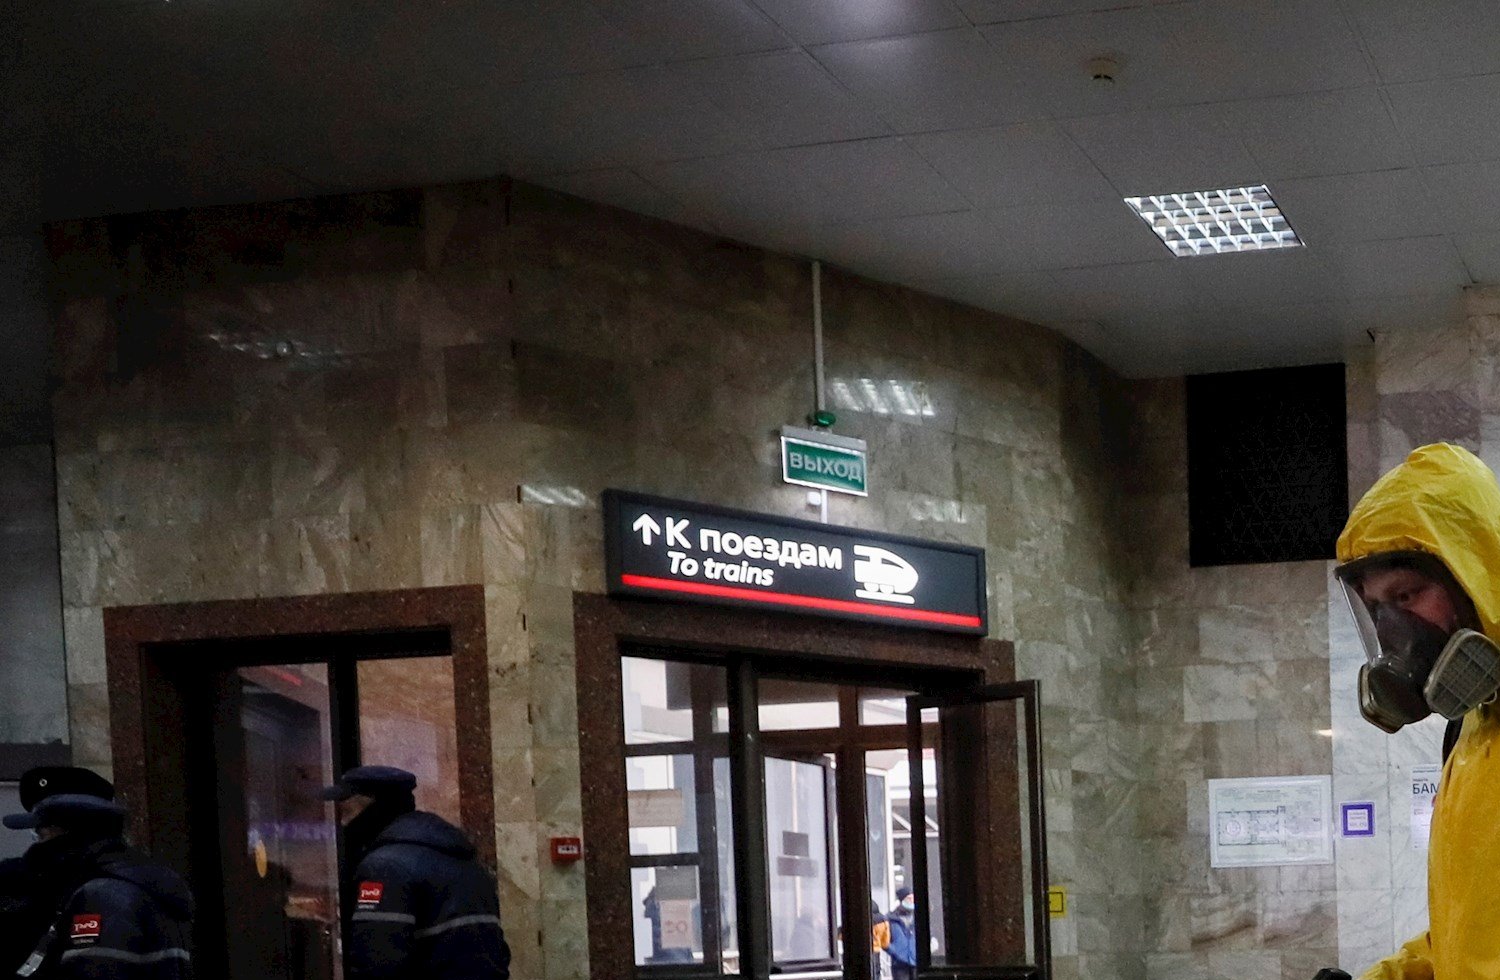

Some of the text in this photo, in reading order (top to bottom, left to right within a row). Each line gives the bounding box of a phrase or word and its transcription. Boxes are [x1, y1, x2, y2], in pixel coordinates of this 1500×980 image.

[789, 452, 862, 483] ВЫХОД
[665, 516, 843, 571] К поездам
[667, 550, 775, 587] To trains
